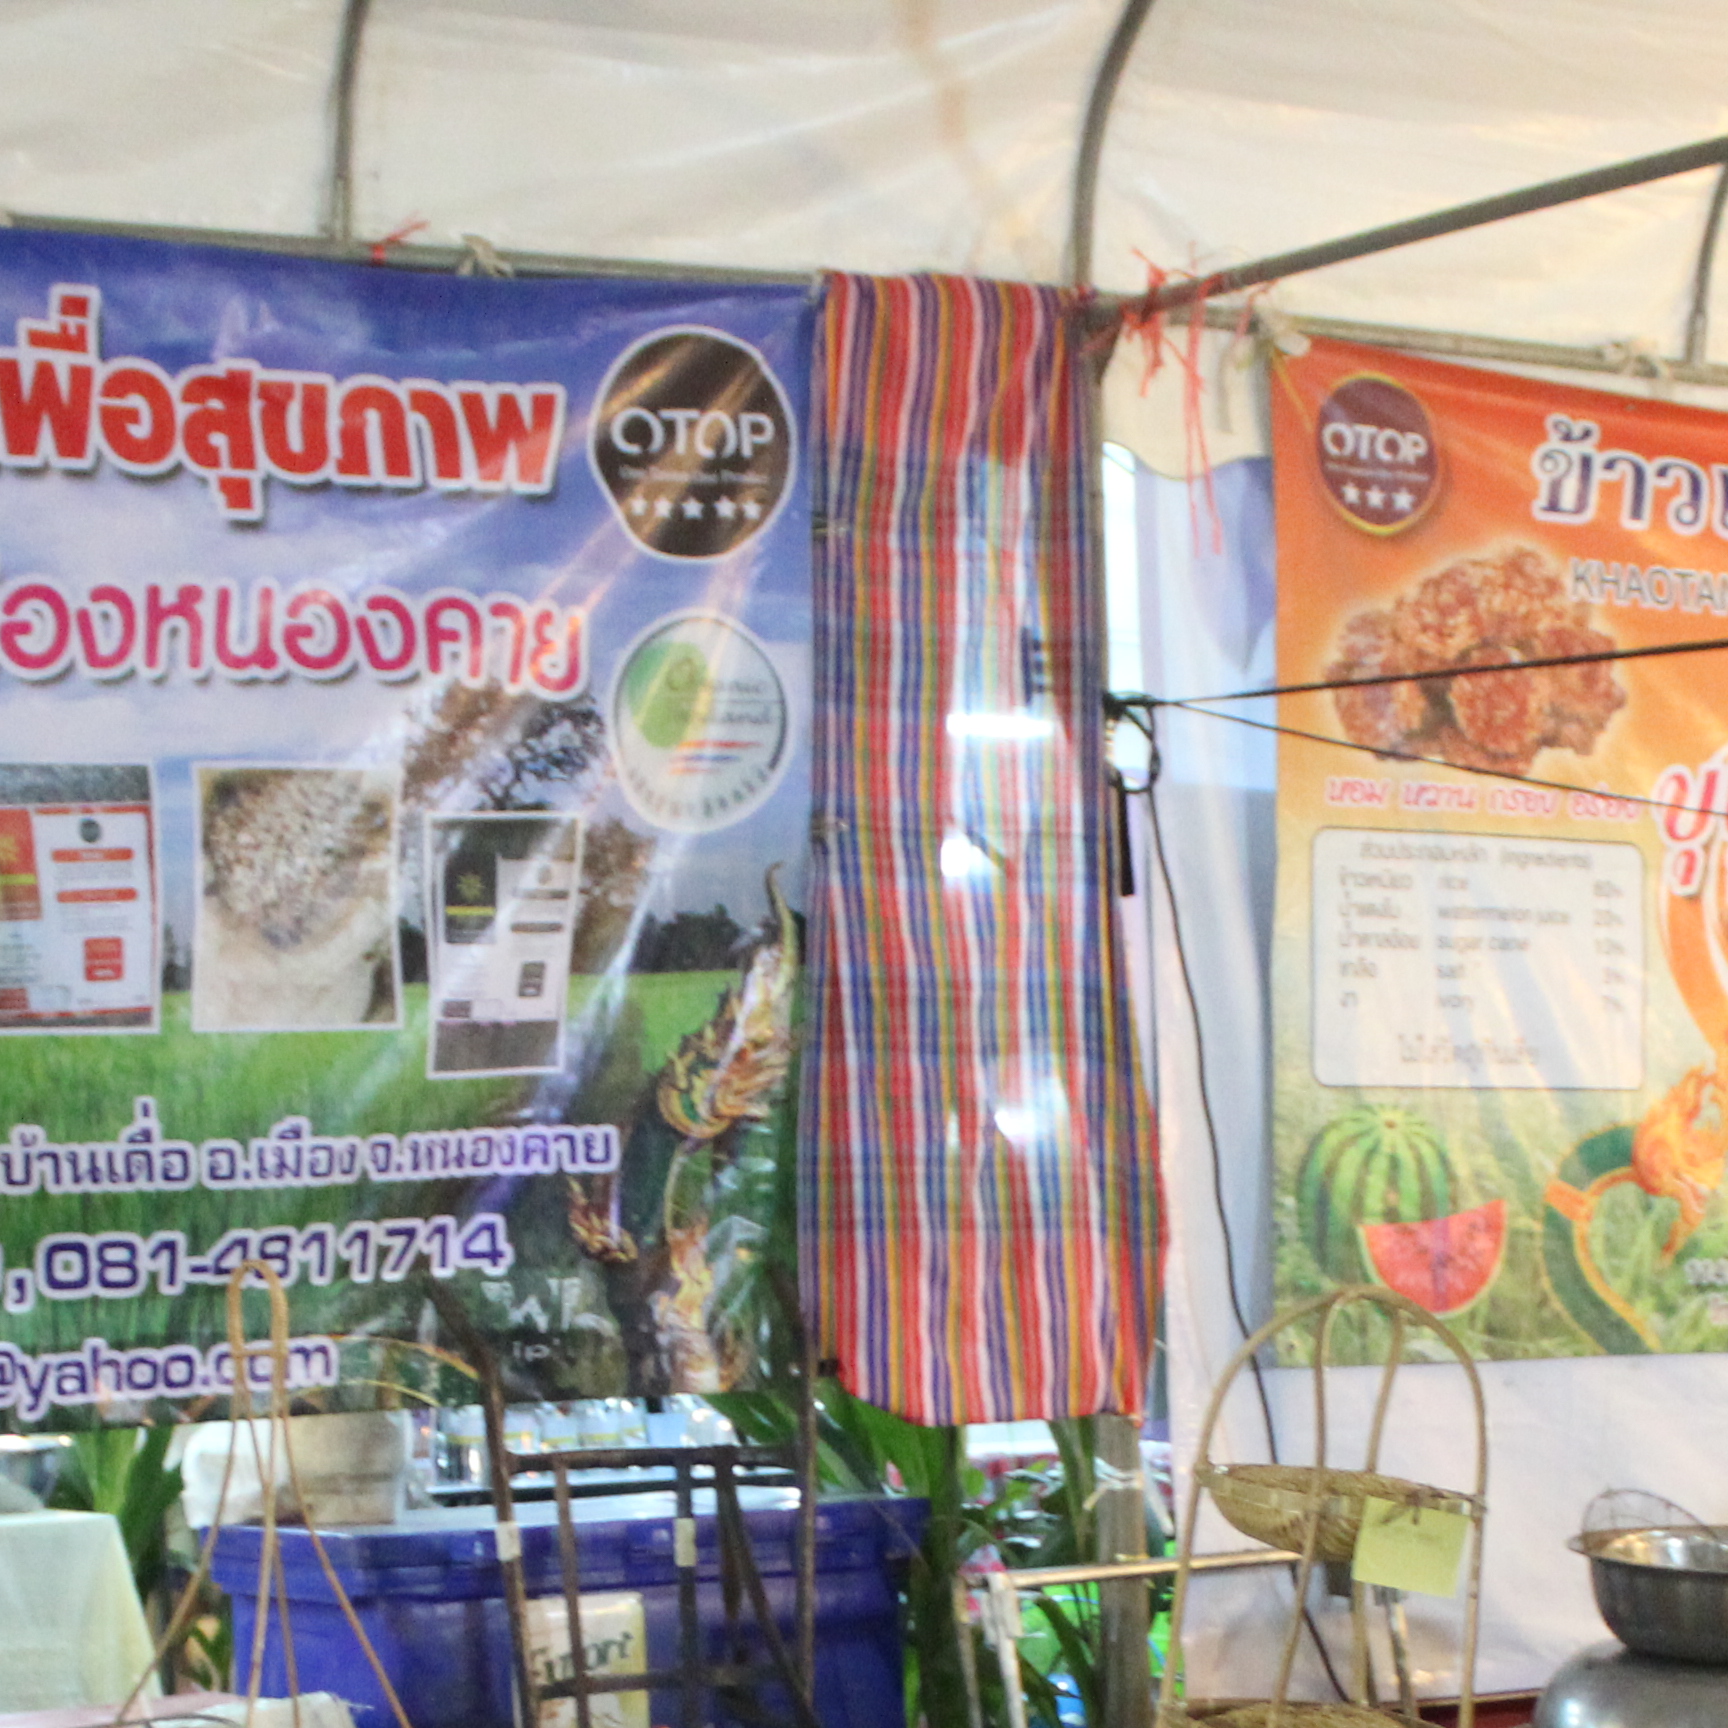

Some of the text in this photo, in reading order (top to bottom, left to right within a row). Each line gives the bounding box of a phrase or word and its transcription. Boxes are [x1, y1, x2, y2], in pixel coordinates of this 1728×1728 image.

[610, 406, 776, 459] OTOP
[1321, 421, 1429, 466] OTOP
[206, 1119, 361, 1184] อ.เมือง
[368, 1126, 615, 1178] จ.หนองคาย
